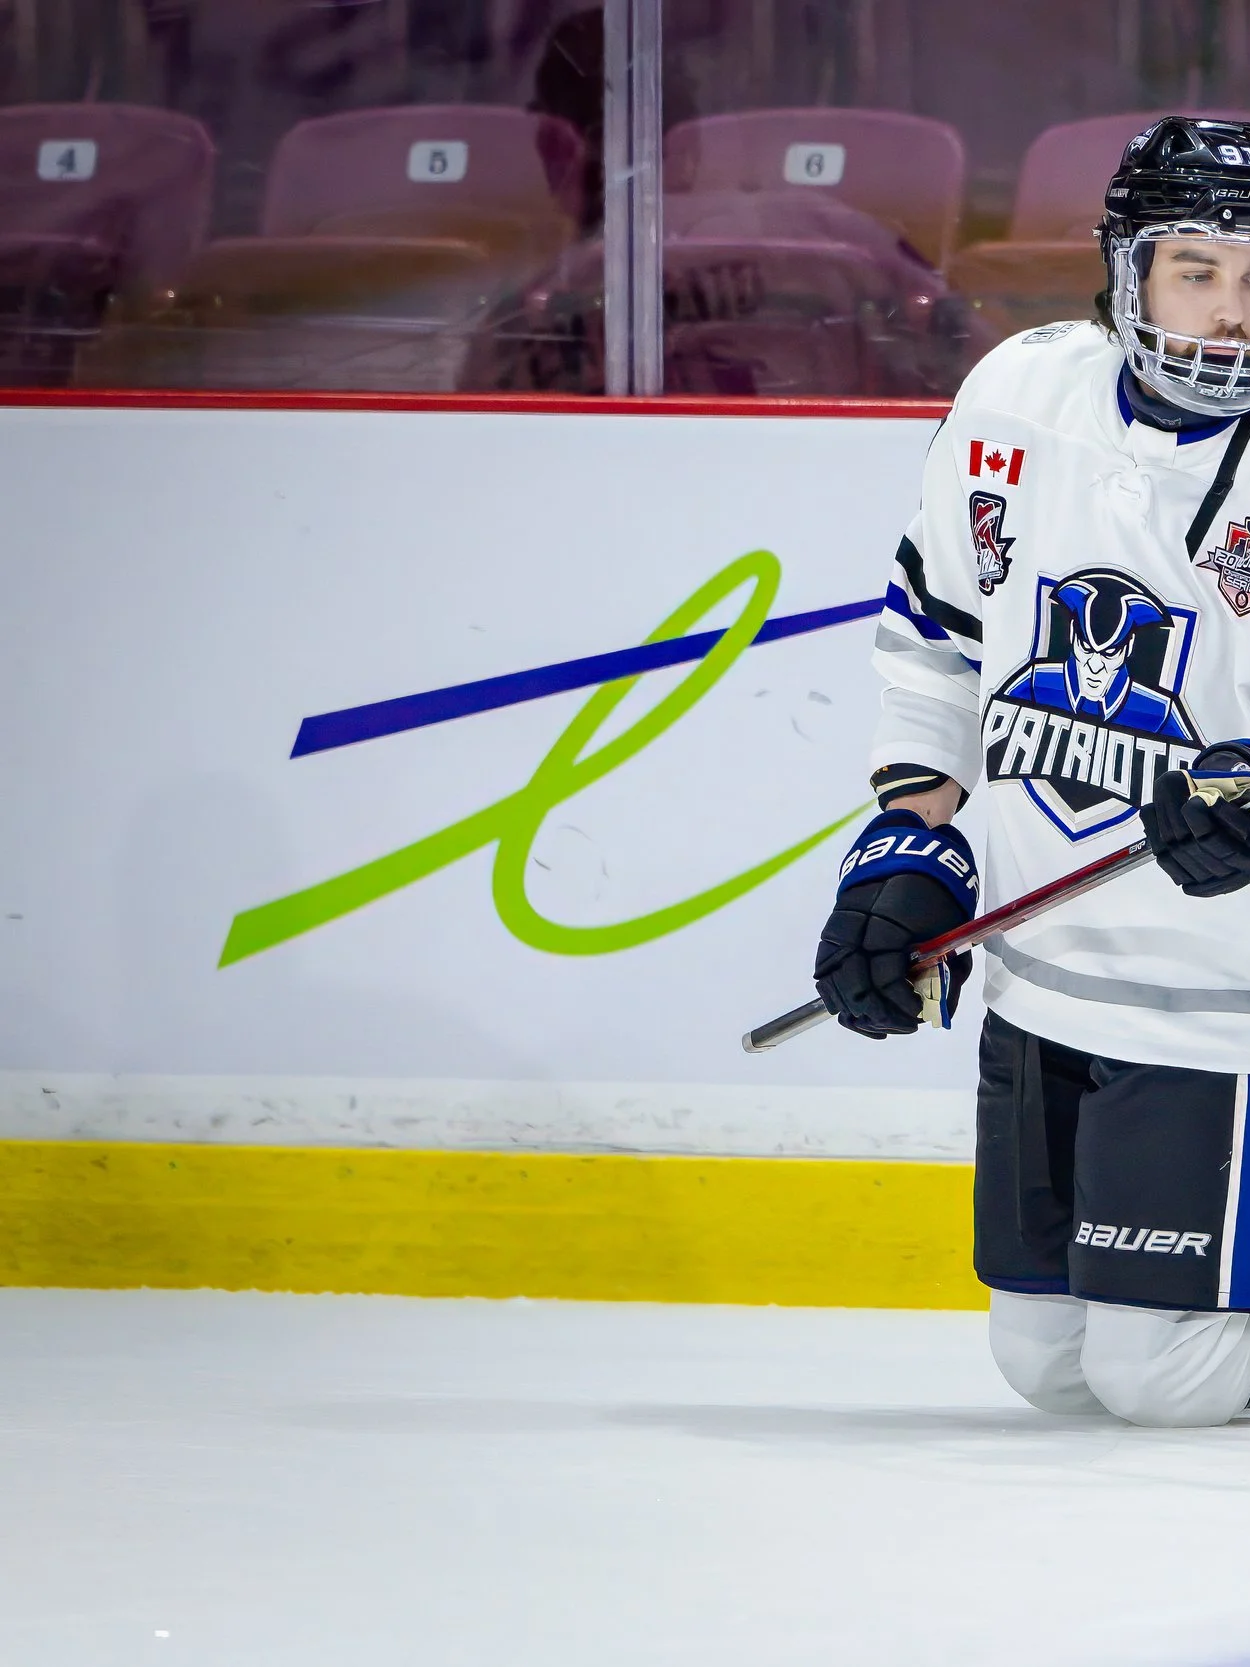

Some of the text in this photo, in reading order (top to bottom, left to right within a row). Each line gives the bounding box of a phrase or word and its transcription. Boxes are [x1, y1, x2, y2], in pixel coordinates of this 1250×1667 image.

[55, 146, 77, 174] 4
[428, 148, 449, 175] 5
[805, 152, 824, 178] 6
[1215, 551, 1237, 567] 20
